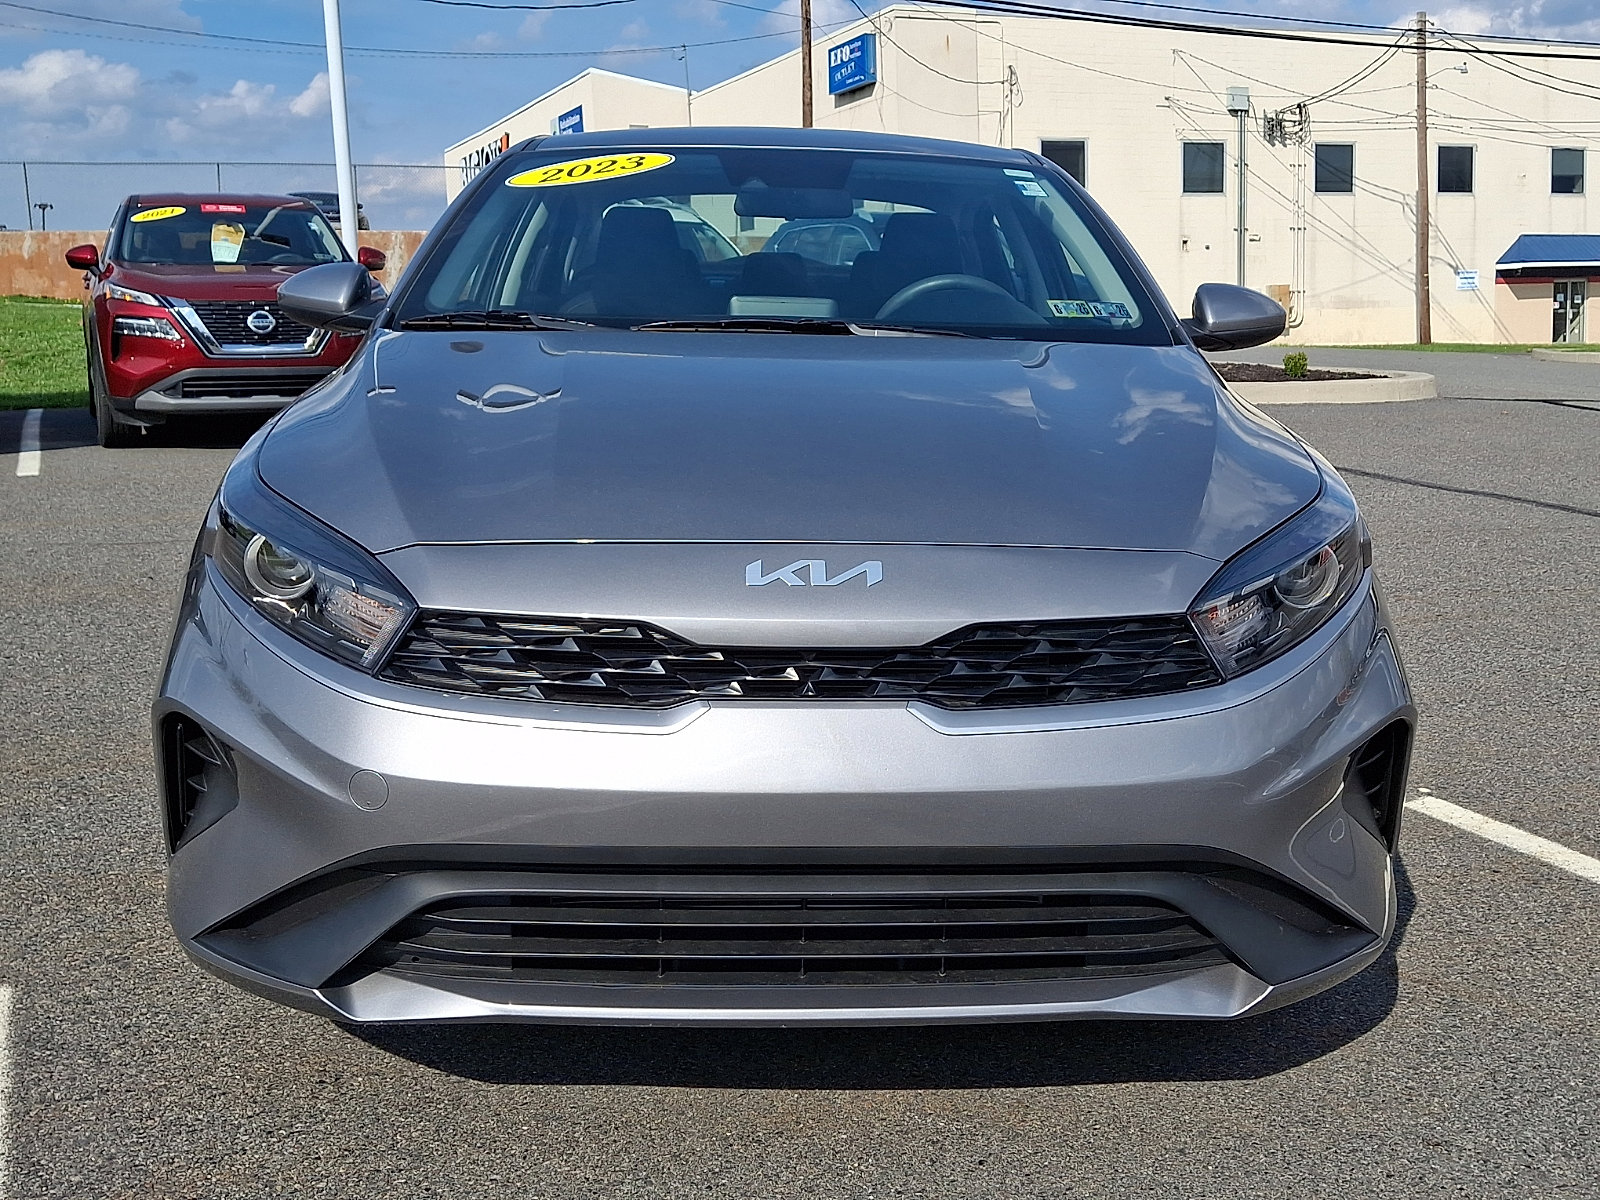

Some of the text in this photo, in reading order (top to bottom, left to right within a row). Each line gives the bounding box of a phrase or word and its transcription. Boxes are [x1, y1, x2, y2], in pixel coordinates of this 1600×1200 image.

[830, 45, 850, 67] EFO
[538, 156, 646, 183] 2023
[142, 208, 175, 219] 2021
